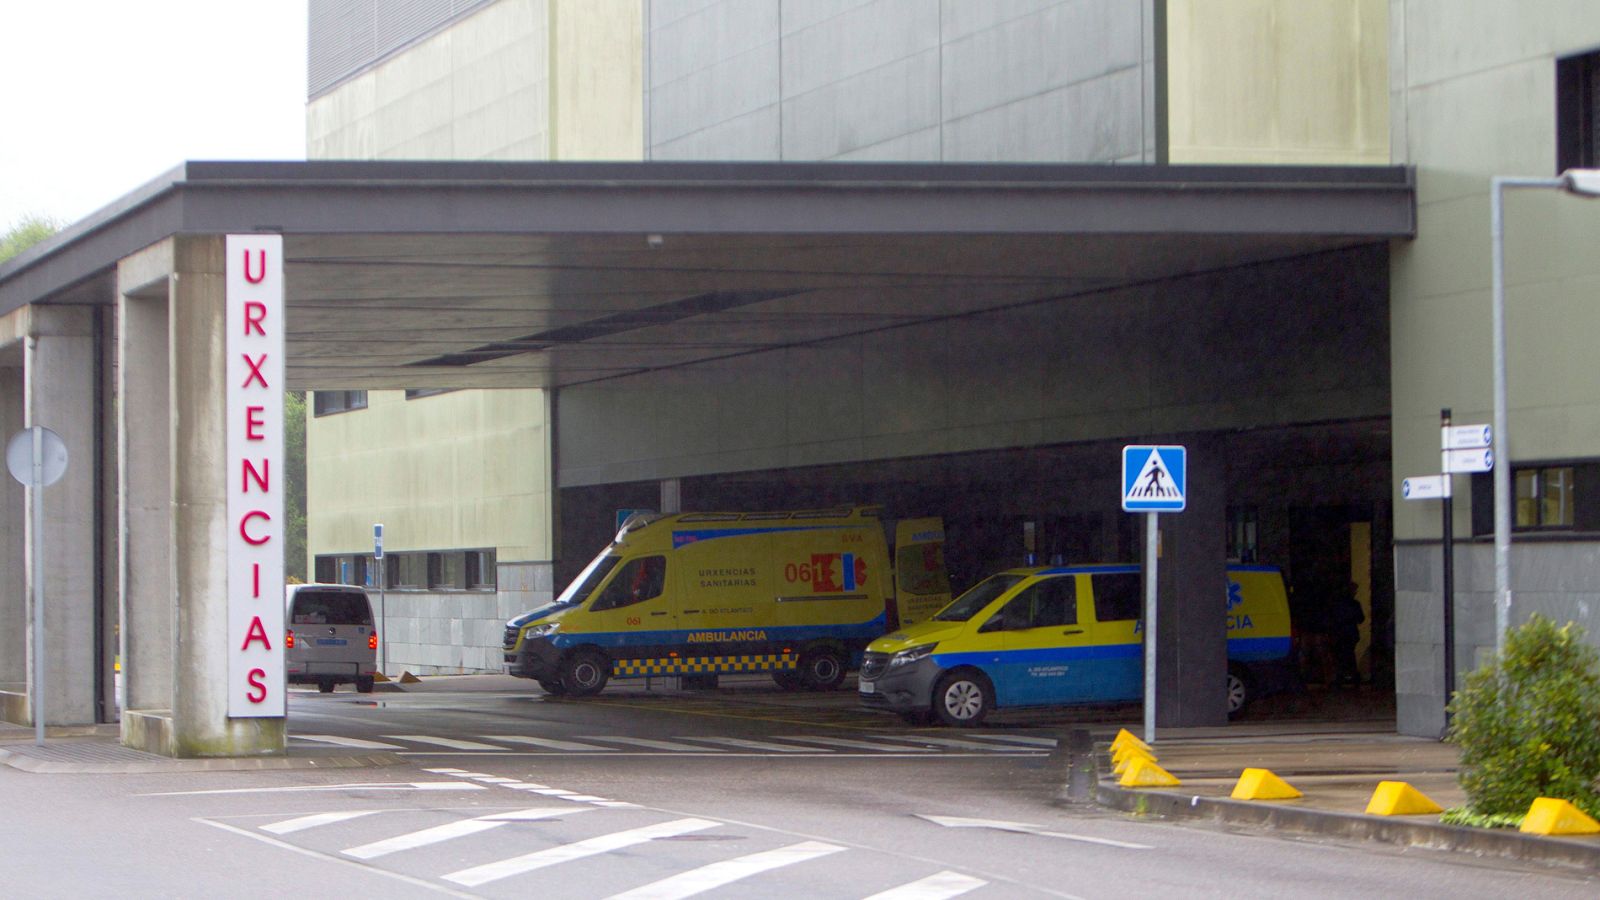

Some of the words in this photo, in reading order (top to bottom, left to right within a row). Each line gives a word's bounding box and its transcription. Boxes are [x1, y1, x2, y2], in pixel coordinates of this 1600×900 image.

[238, 247, 271, 704] URXENCIAS
[698, 567, 757, 577] URXENCIAS
[784, 562, 824, 583] 061
[700, 578, 757, 588] SANITARIAS
[626, 616, 641, 626] 061
[687, 629, 768, 643] AMBULANCIA
